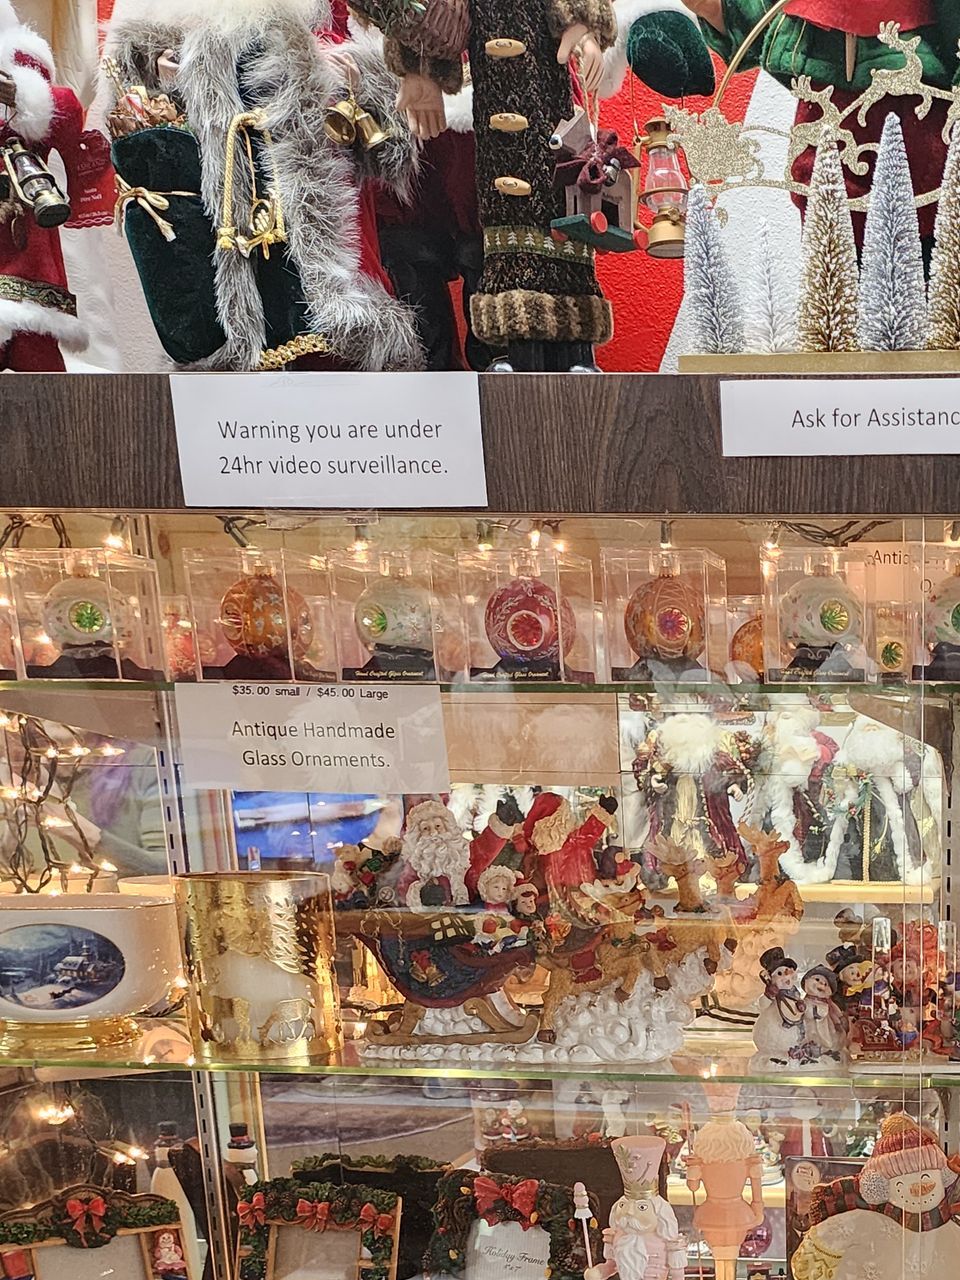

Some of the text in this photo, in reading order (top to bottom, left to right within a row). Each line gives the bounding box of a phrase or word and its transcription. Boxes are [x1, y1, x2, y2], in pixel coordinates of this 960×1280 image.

[791, 408, 826, 428] Ask
[832, 407, 861, 428] for
[217, 419, 442, 443] Warning you are under
[219, 455, 449, 474] 24hr video surveillance.
[232, 685, 270, 696] $35.00
[275, 686, 300, 697] small
[317, 687, 355, 698] $45.00
[360, 688, 389, 700] Large
[231, 721, 396, 741] Antique Handmade
[242, 750, 391, 768] Glass Ornaments.
[481, 1245, 545, 1266] Holiday Frame
